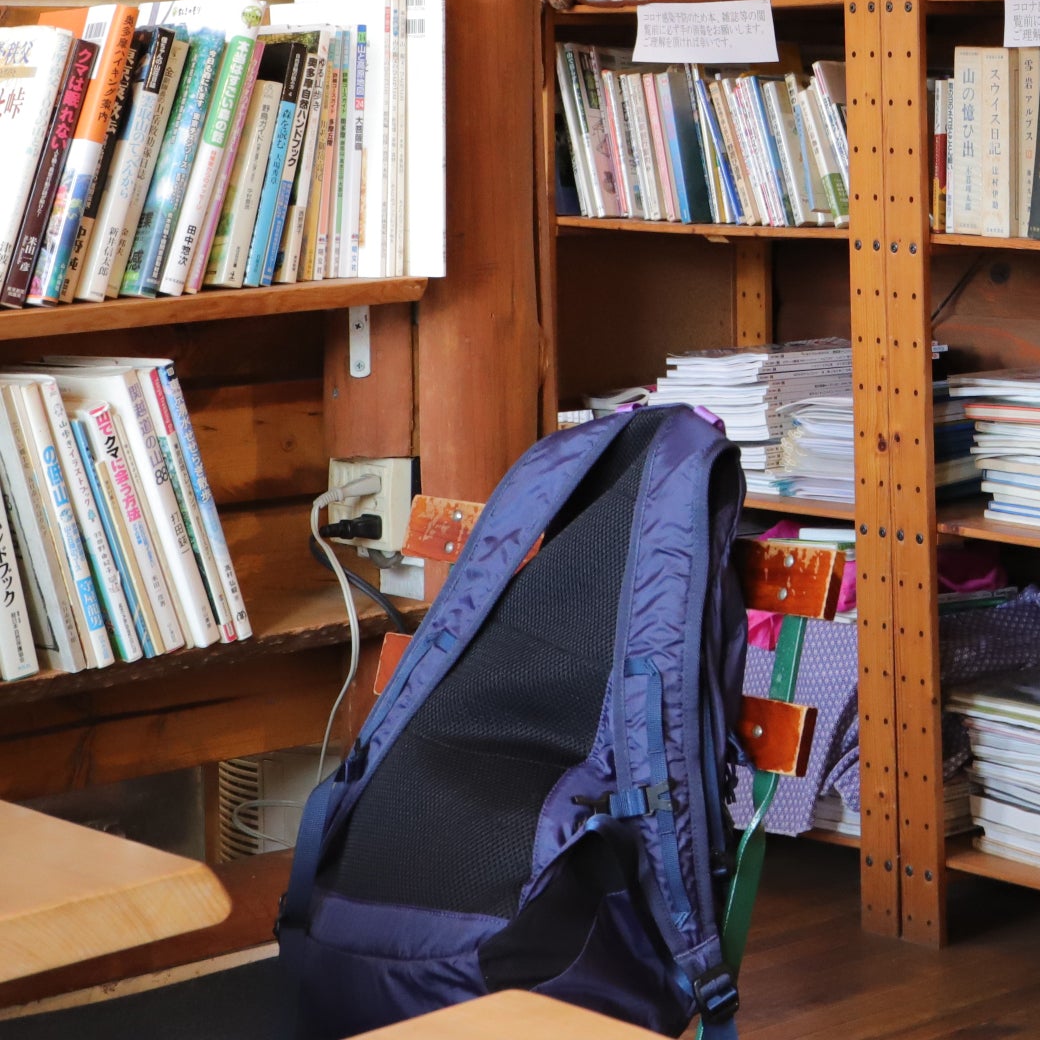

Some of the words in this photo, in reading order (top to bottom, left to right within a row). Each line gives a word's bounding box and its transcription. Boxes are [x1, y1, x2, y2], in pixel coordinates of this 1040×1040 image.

[51, 48, 92, 150] クマは眠れない
[98, 15, 135, 122] 奥多摩ハイキング案内
[211, 40, 250, 144] 本当はすごい森の話
[288, 57, 318, 167] 奥多摩自然ハンドブック
[355, 99, 365, 109] 24
[962, 68, 975, 158] 山の憶ひ出
[989, 69, 1001, 156] スウイス日記
[1024, 59, 1033, 141] 雪岩アルプス
[178, 225, 197, 266] 田中惣次
